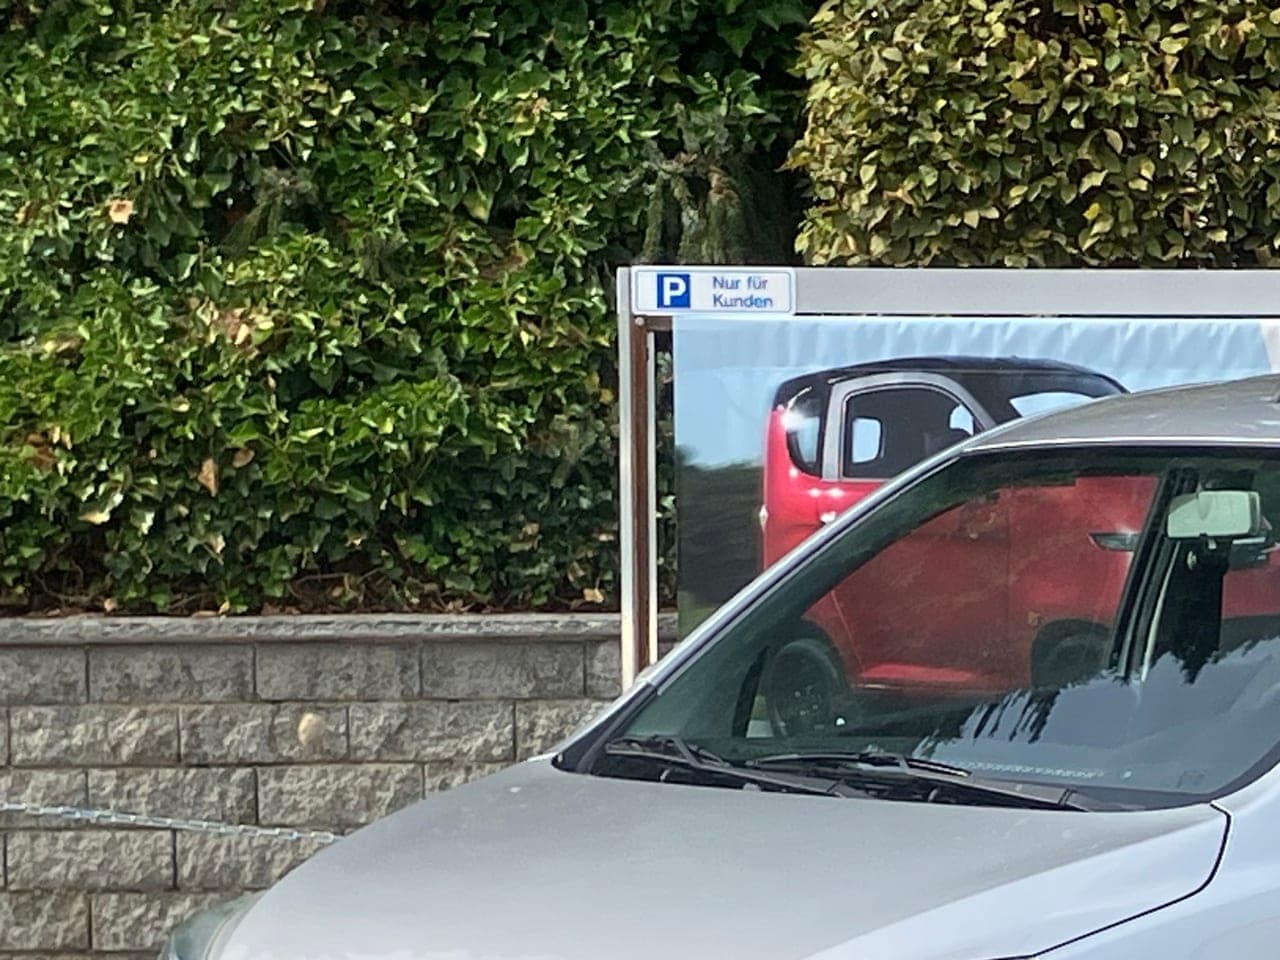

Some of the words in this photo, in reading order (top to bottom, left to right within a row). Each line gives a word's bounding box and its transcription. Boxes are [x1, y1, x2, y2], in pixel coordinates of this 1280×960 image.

[712, 276, 740, 290] Nur
[747, 275, 769, 290] für
[662, 276, 687, 307] P
[712, 294, 773, 308] Kunden
